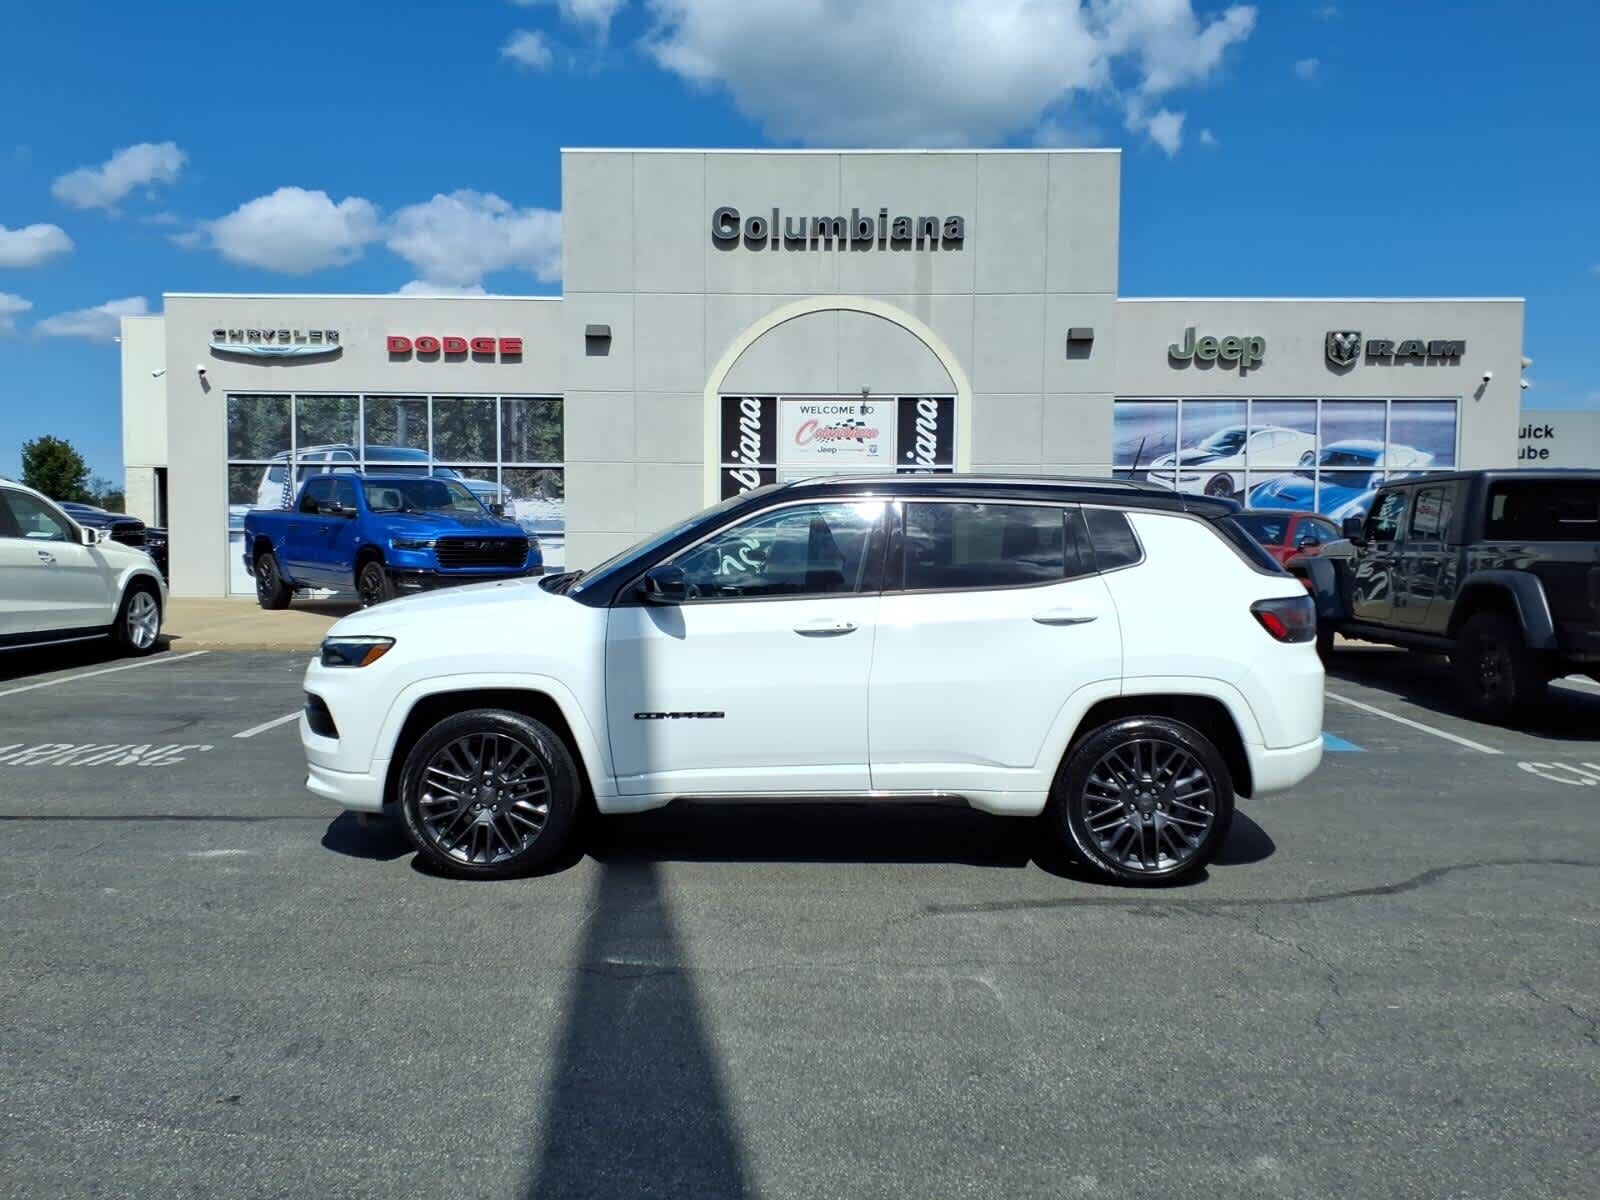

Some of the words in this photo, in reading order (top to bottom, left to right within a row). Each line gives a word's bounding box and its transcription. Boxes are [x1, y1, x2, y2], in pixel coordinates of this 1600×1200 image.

[711, 206, 965, 243] Columbiana
[212, 329, 340, 342] CHRYSLER
[387, 335, 523, 355] DODGE
[1168, 326, 1266, 369] Jeep
[1365, 339, 1466, 358] RAM
[799, 406, 855, 415] WELCOME
[729, 397, 761, 495] biana
[906, 398, 938, 473] iana
[0, 743, 215, 767] RKING
